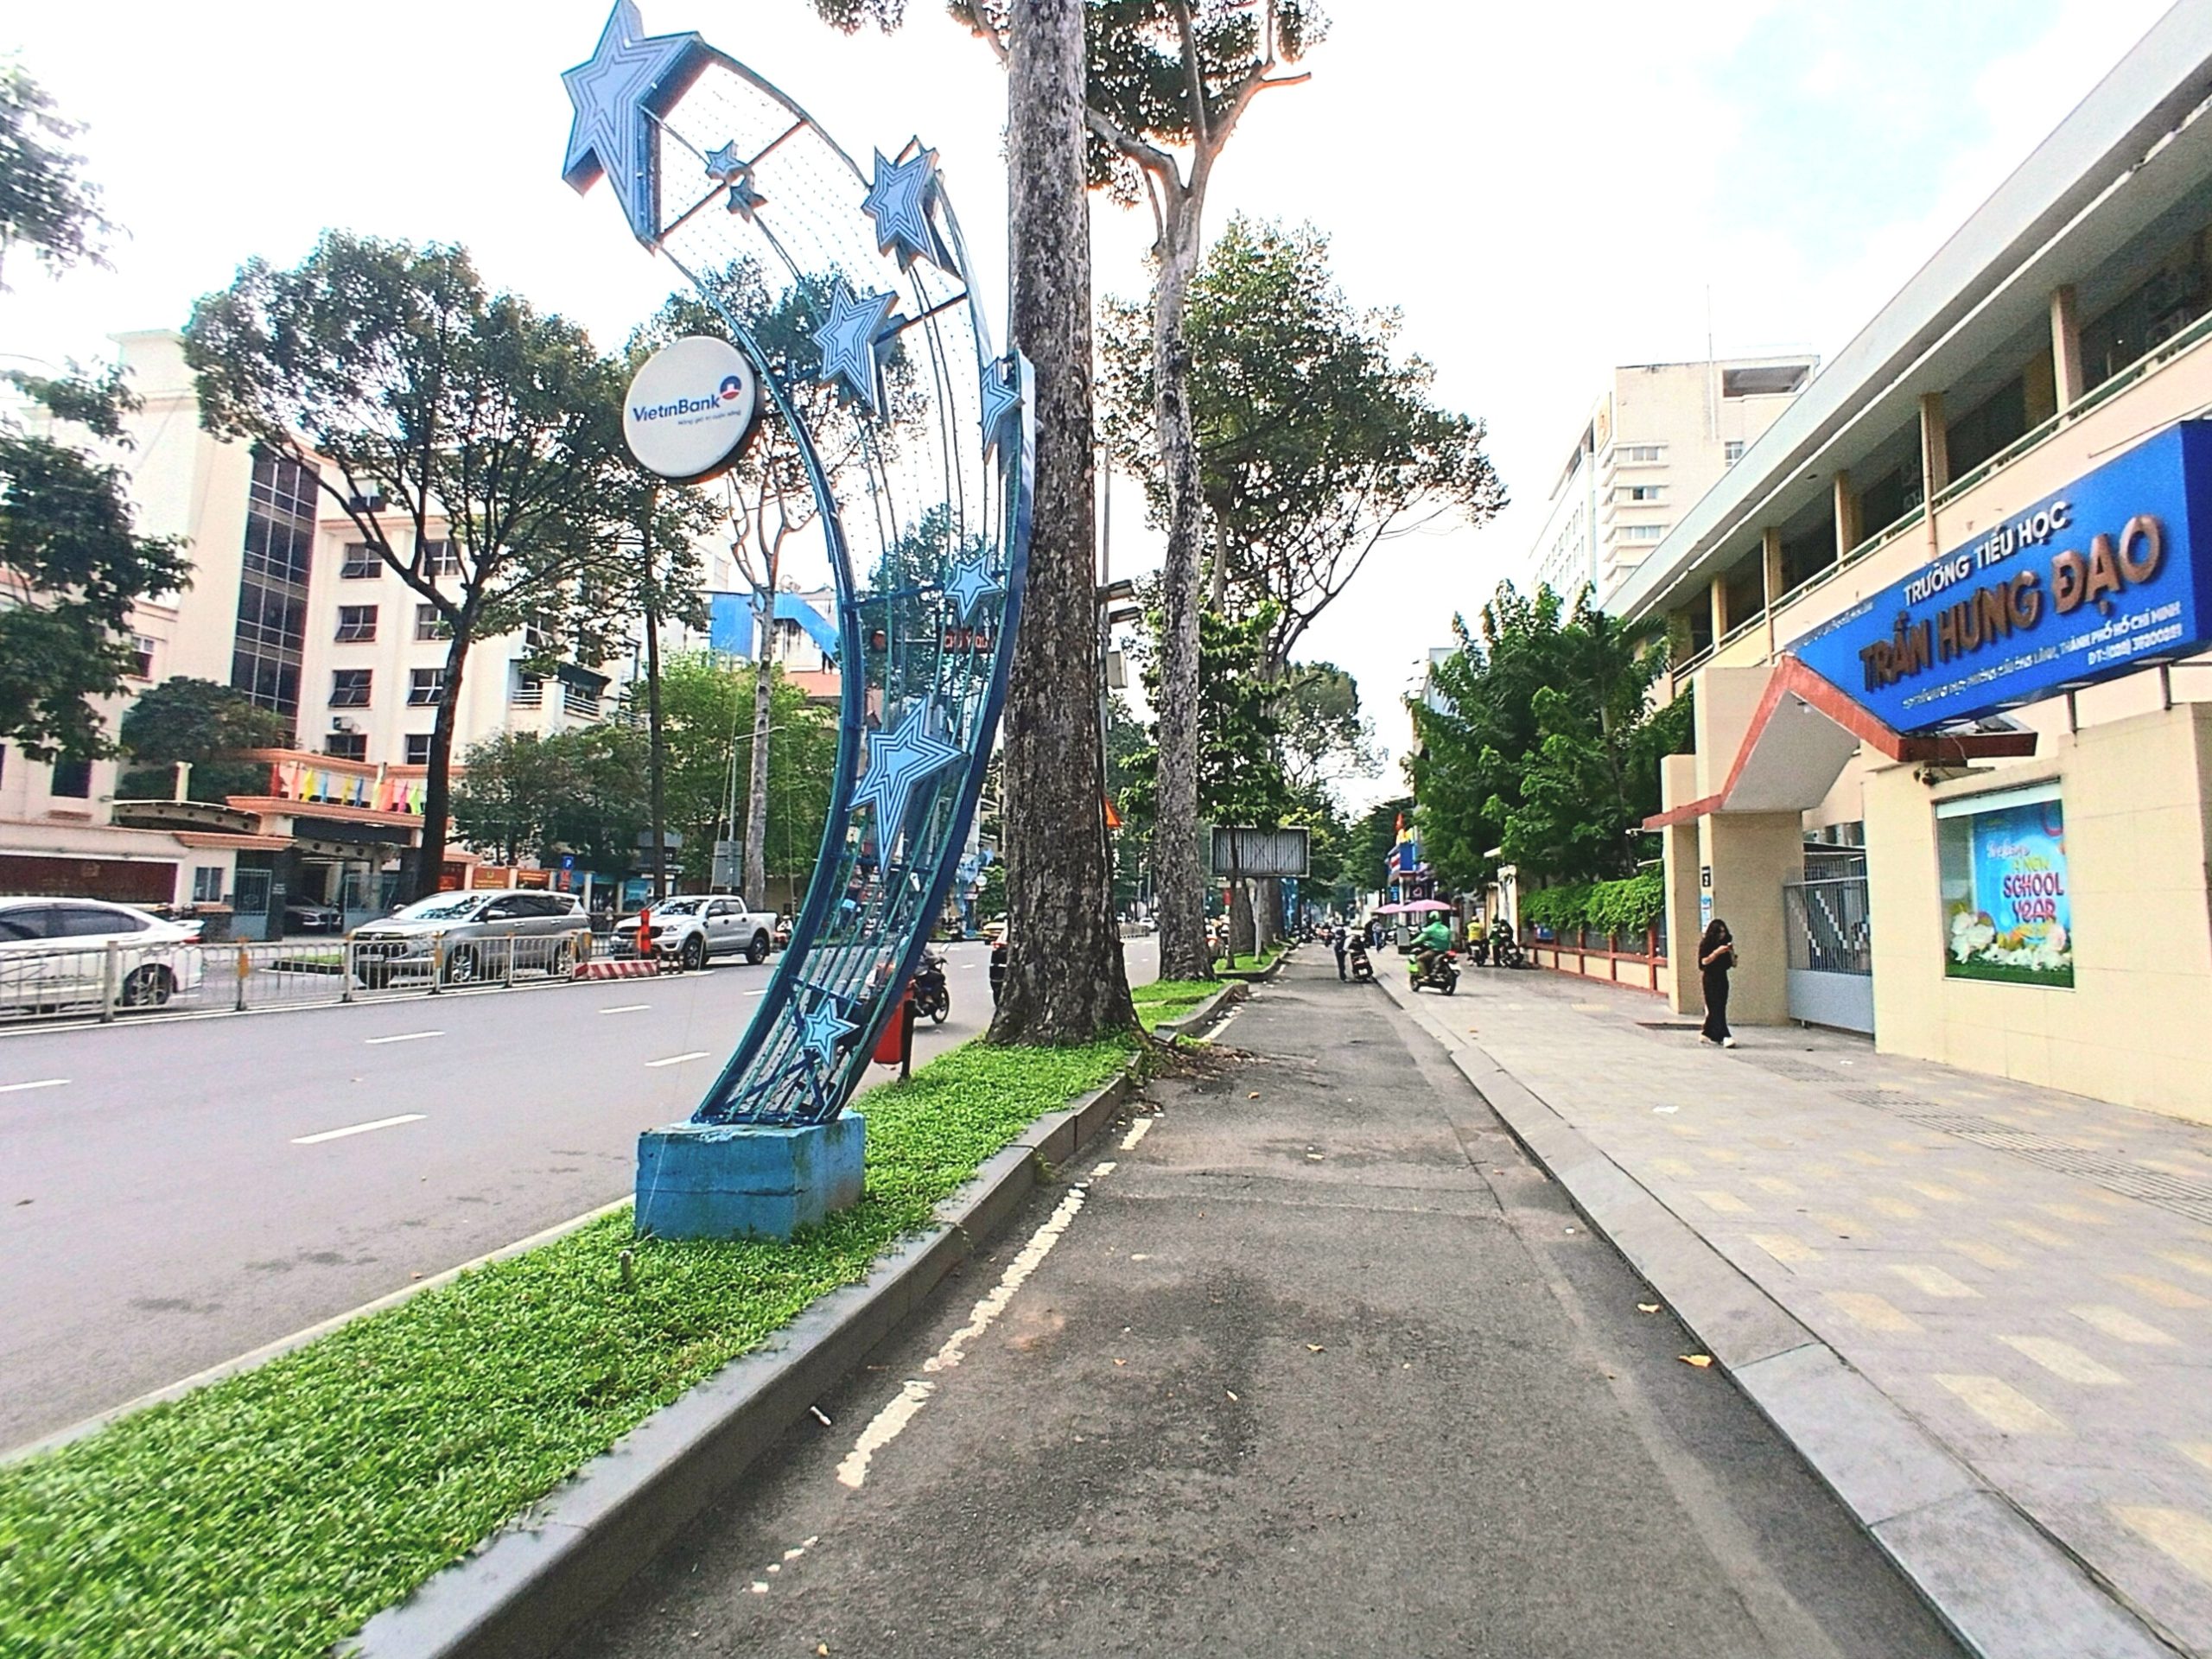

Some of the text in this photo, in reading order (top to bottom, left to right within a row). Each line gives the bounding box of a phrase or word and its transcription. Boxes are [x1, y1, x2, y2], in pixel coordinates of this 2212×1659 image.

[633, 394, 720, 423] VietinBank
[1904, 500, 2068, 607] TRƯỜNG TIỂU HỌC
[1859, 611, 1932, 691] TRẦN
[1938, 571, 2042, 664] HƯNG
[2052, 514, 2163, 615] ĐẠO
[2003, 871, 2065, 899] SCHOOL
